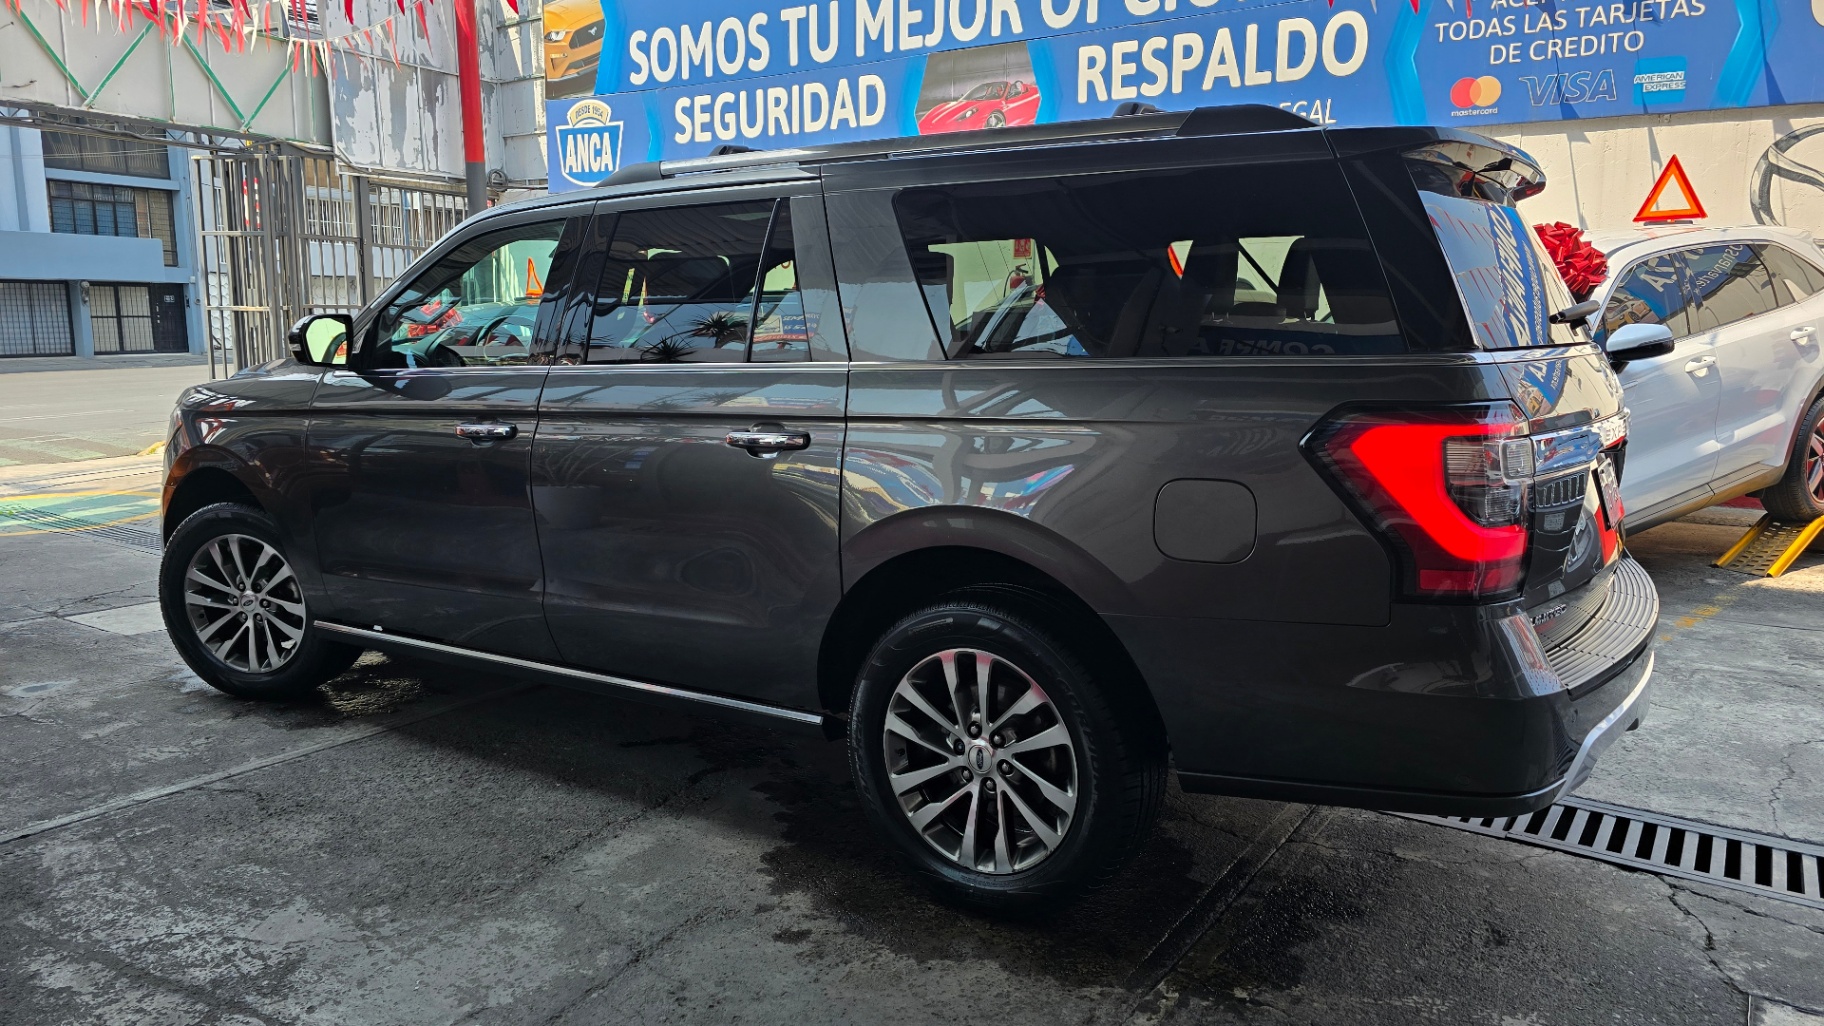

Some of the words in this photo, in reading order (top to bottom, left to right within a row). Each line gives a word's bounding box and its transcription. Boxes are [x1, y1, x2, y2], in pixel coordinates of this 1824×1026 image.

[1434, 15, 1516, 43] TODAS
[1524, 10, 1567, 33] LAS
[1575, 0, 1706, 28] TARJETAS
[629, 12, 771, 86] SOMOS
[780, 0, 839, 67] TU
[855, 0, 1023, 58] MEJOR
[1078, 10, 1369, 104] RESPALDO
[1490, 42, 1522, 65] DE
[1529, 31, 1645, 61] CREDITO
[1519, 69, 1617, 107] VISA
[1634, 72, 1685, 84] AMERICAN
[1643, 81, 1686, 92] EXPRESS
[575, 105, 590, 119] DESDE
[674, 74, 886, 144] SEGURIDAD
[1451, 107, 1498, 117] mastercard
[565, 132, 613, 173] ANCA
